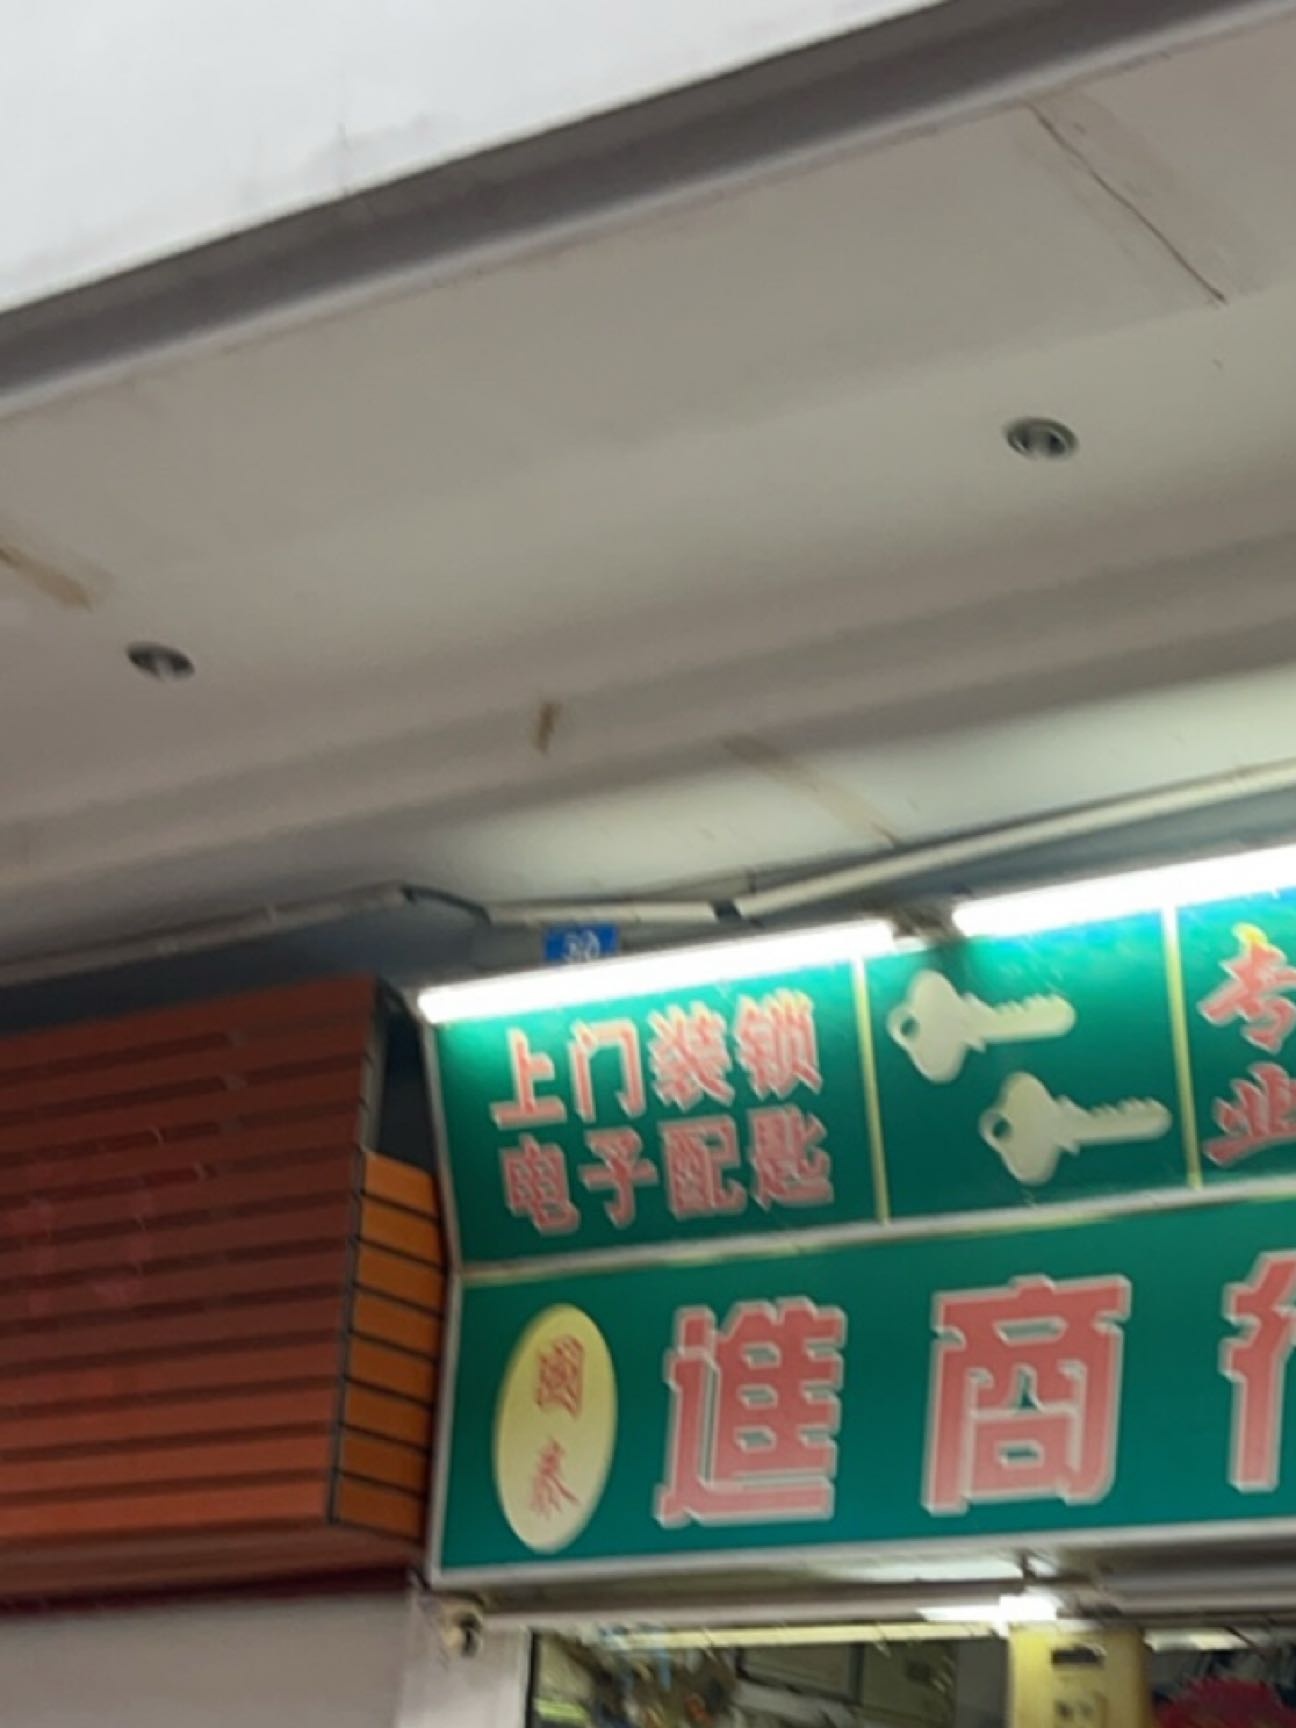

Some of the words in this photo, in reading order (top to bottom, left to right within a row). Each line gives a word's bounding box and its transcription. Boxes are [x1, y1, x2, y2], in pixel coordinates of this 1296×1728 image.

[490, 989, 823, 1128] 上门装锁
[500, 1106, 834, 1235] 电子配匙
